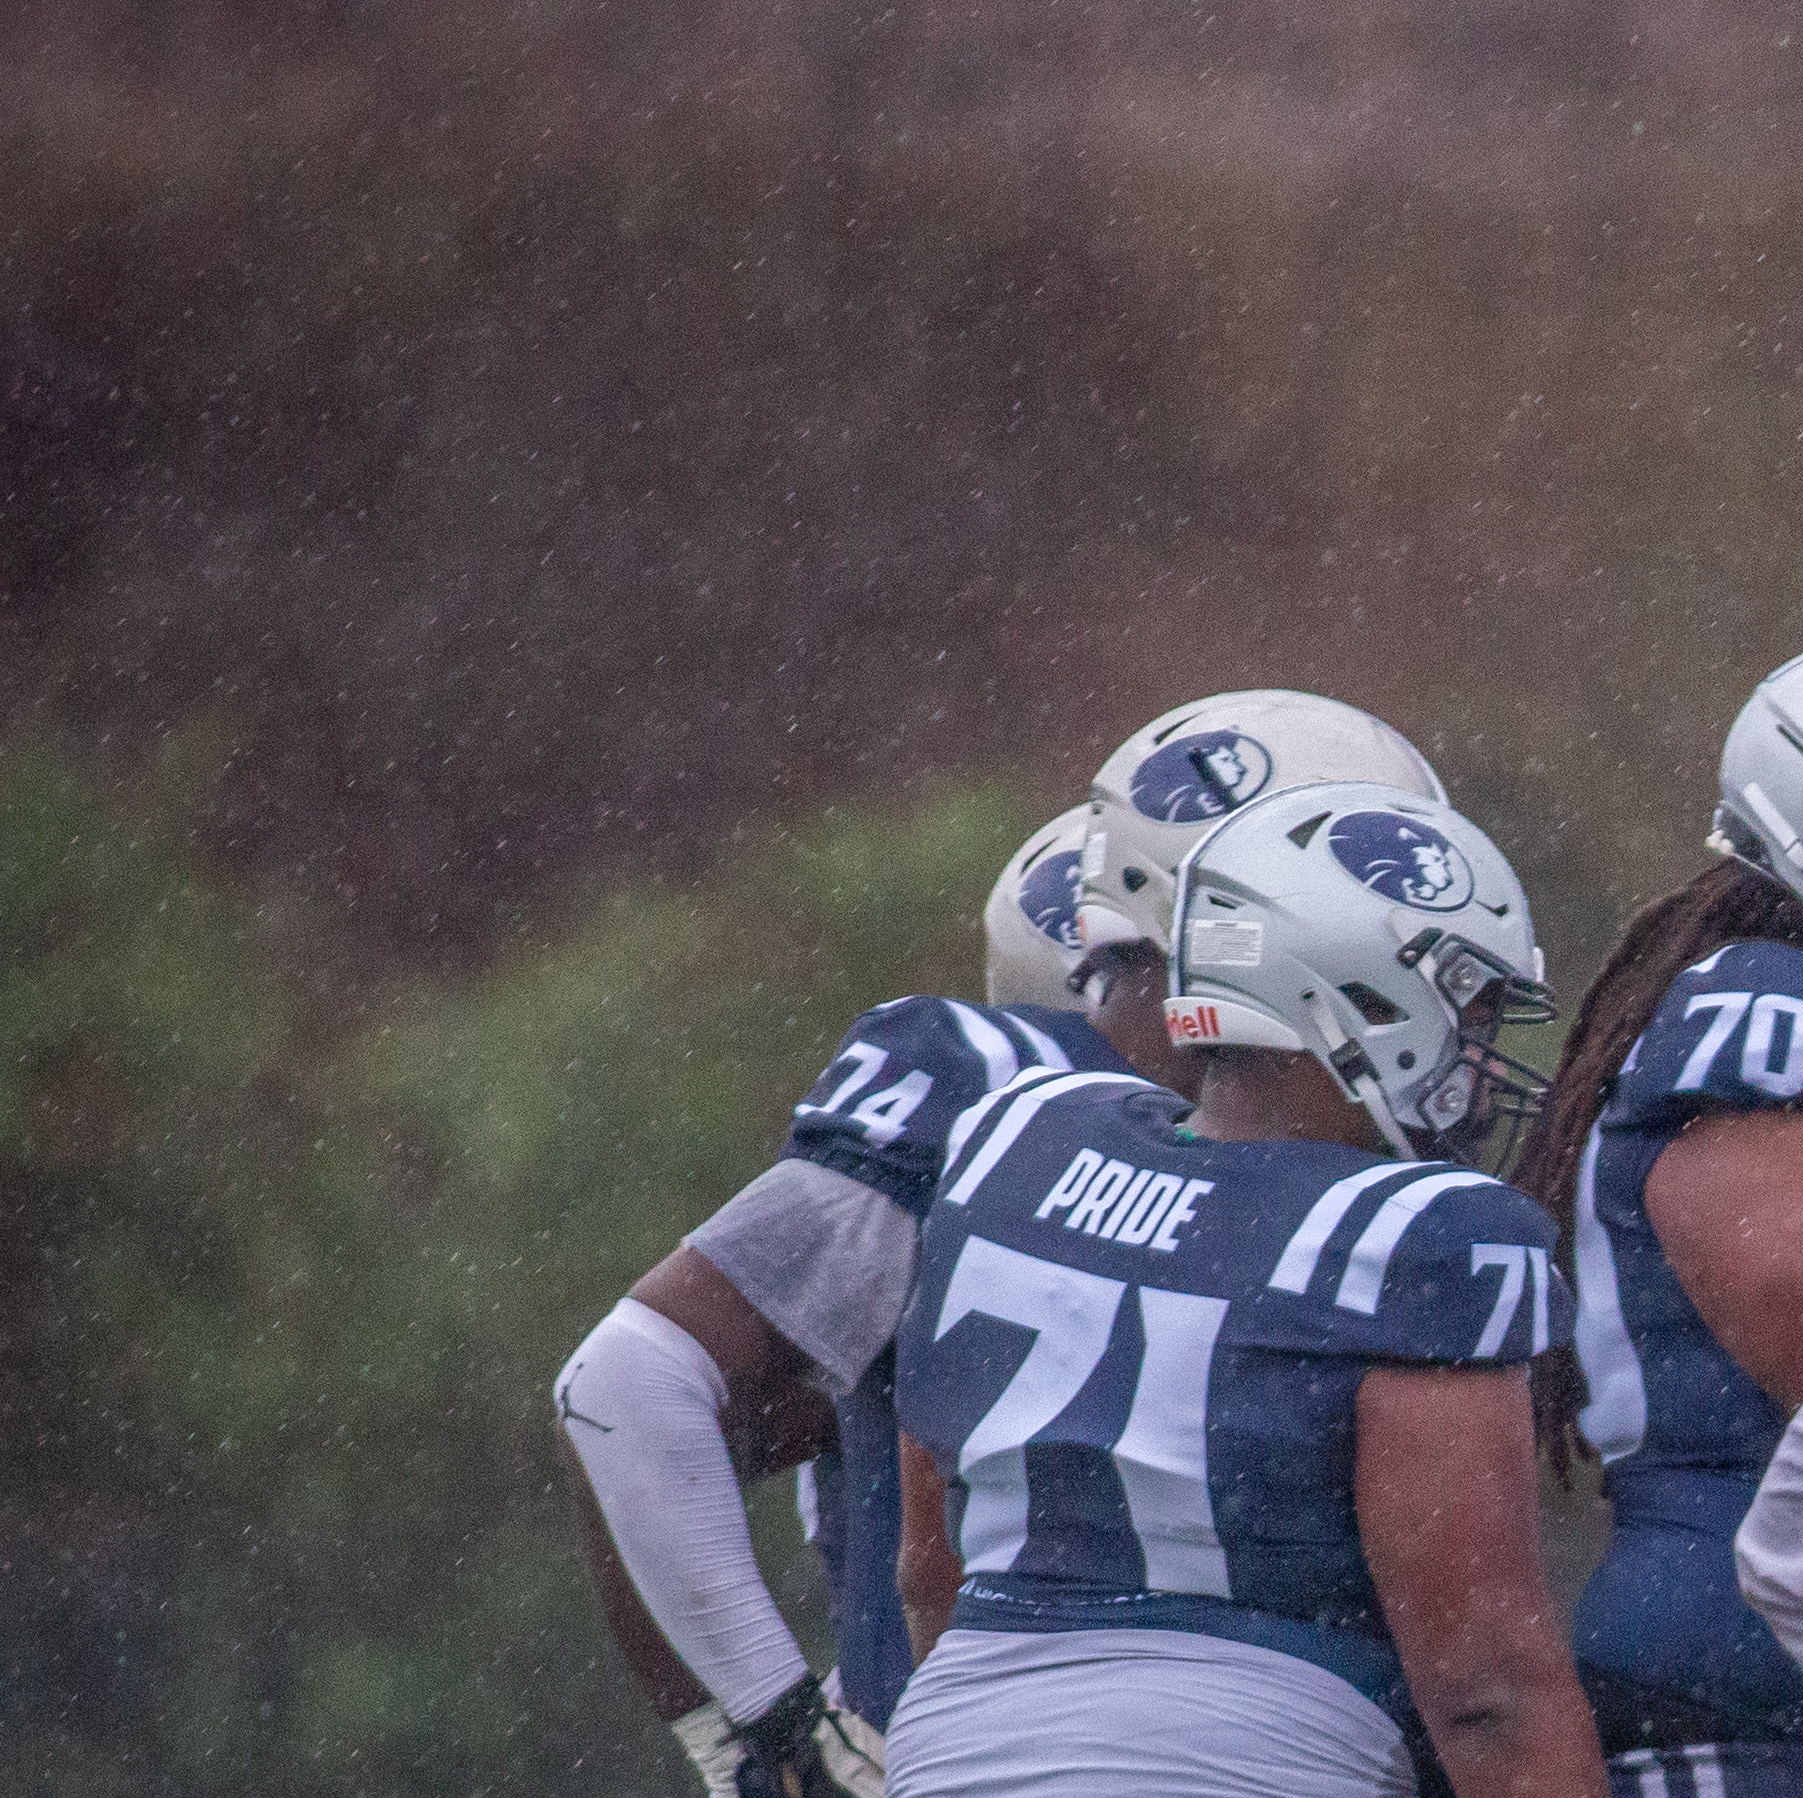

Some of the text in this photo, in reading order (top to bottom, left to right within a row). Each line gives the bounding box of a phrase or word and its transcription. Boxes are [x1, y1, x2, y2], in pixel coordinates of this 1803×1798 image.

[1166, 1006, 1220, 1038] dell
[794, 1041, 932, 1143] 74
[1035, 1148, 1215, 1252] PRIDE
[1471, 1244, 1549, 1357] 71
[934, 1234, 1231, 1601] 71
